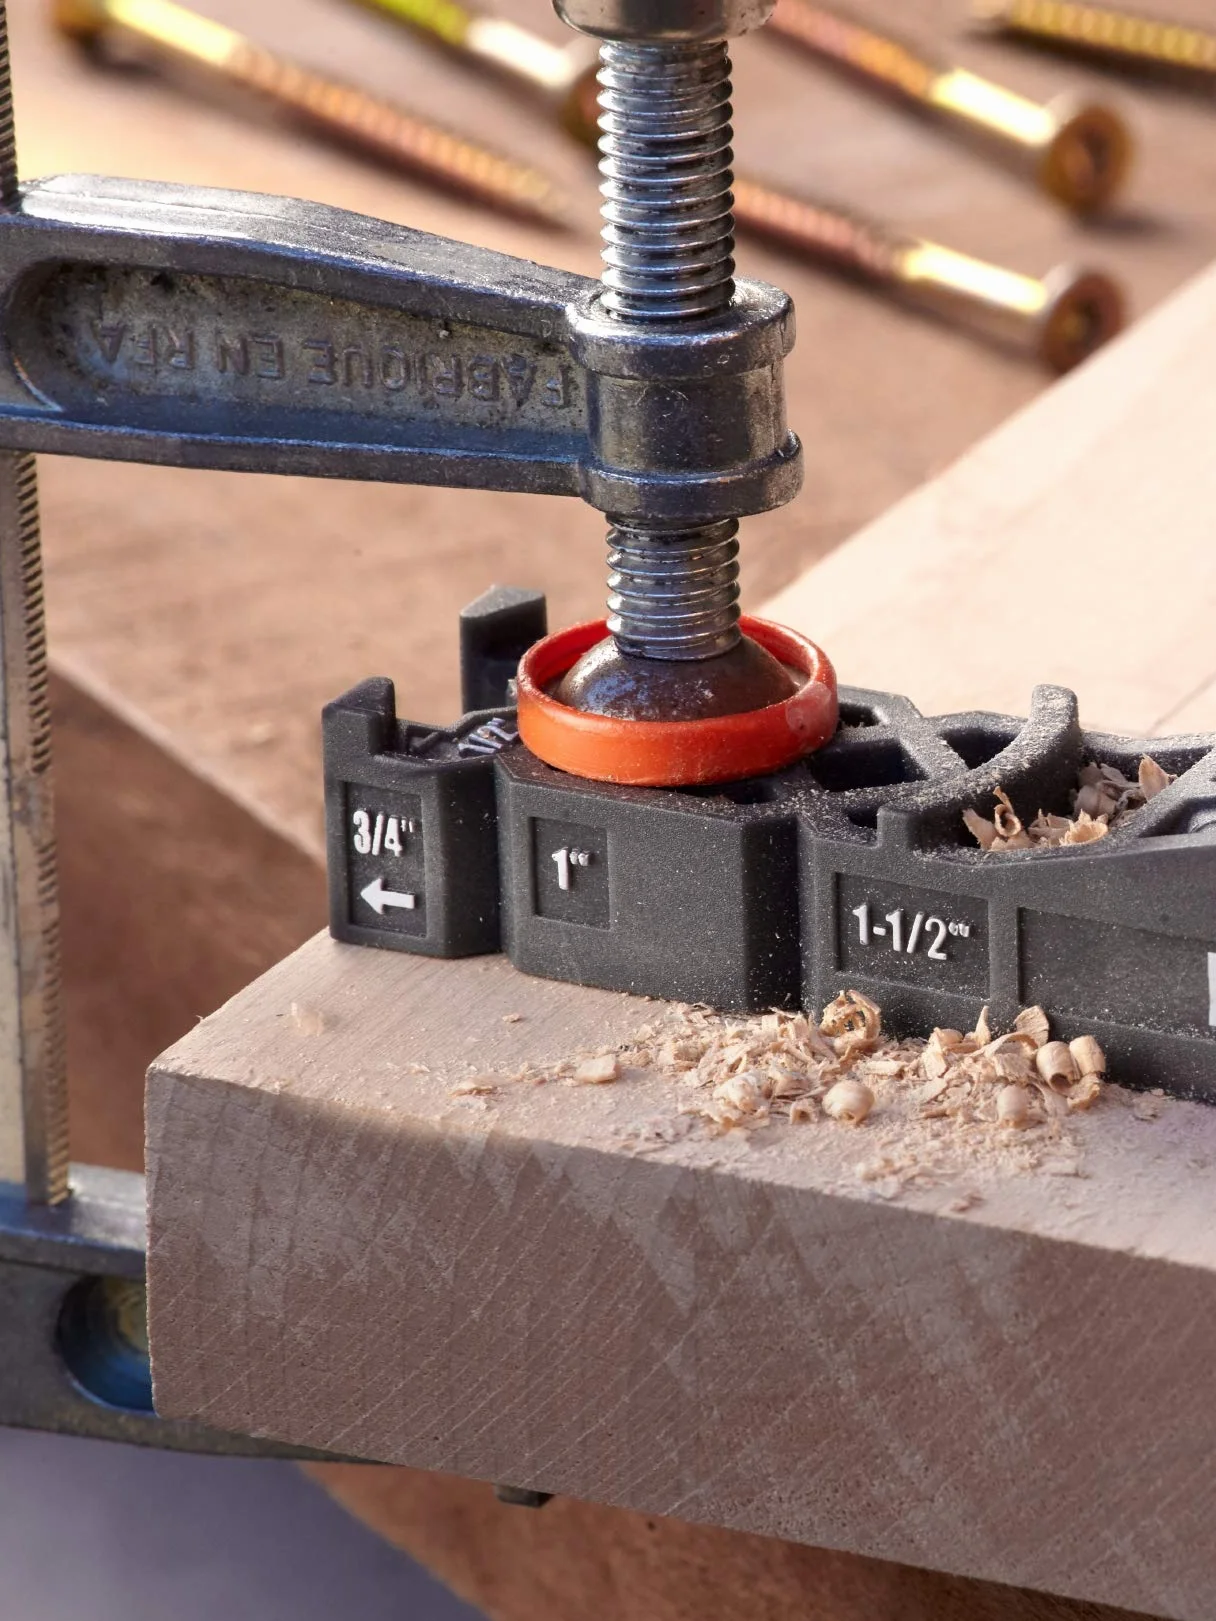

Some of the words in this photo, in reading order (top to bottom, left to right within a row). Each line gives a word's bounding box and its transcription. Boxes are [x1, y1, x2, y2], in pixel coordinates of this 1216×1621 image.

[217, 328, 287, 380] EN
[303, 338, 579, 408] FABRIQUE
[353, 809, 416, 857] 3/4"
